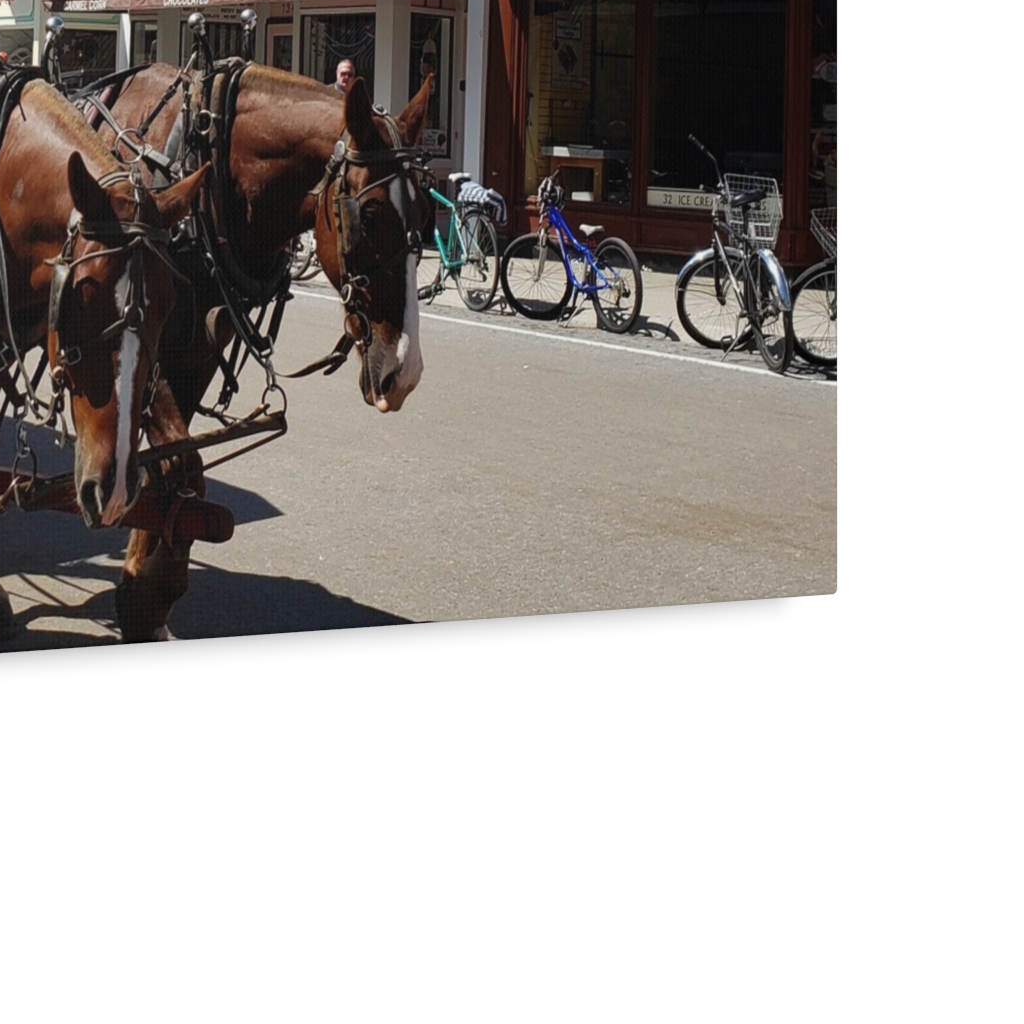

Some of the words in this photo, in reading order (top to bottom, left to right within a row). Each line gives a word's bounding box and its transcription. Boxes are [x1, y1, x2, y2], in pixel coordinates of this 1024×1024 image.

[64, 0, 87, 11] CARMEL
[88, 0, 108, 10] CORN
[662, 193, 673, 205] 32
[678, 195, 691, 206] ICE
[693, 196, 725, 208] CRE
